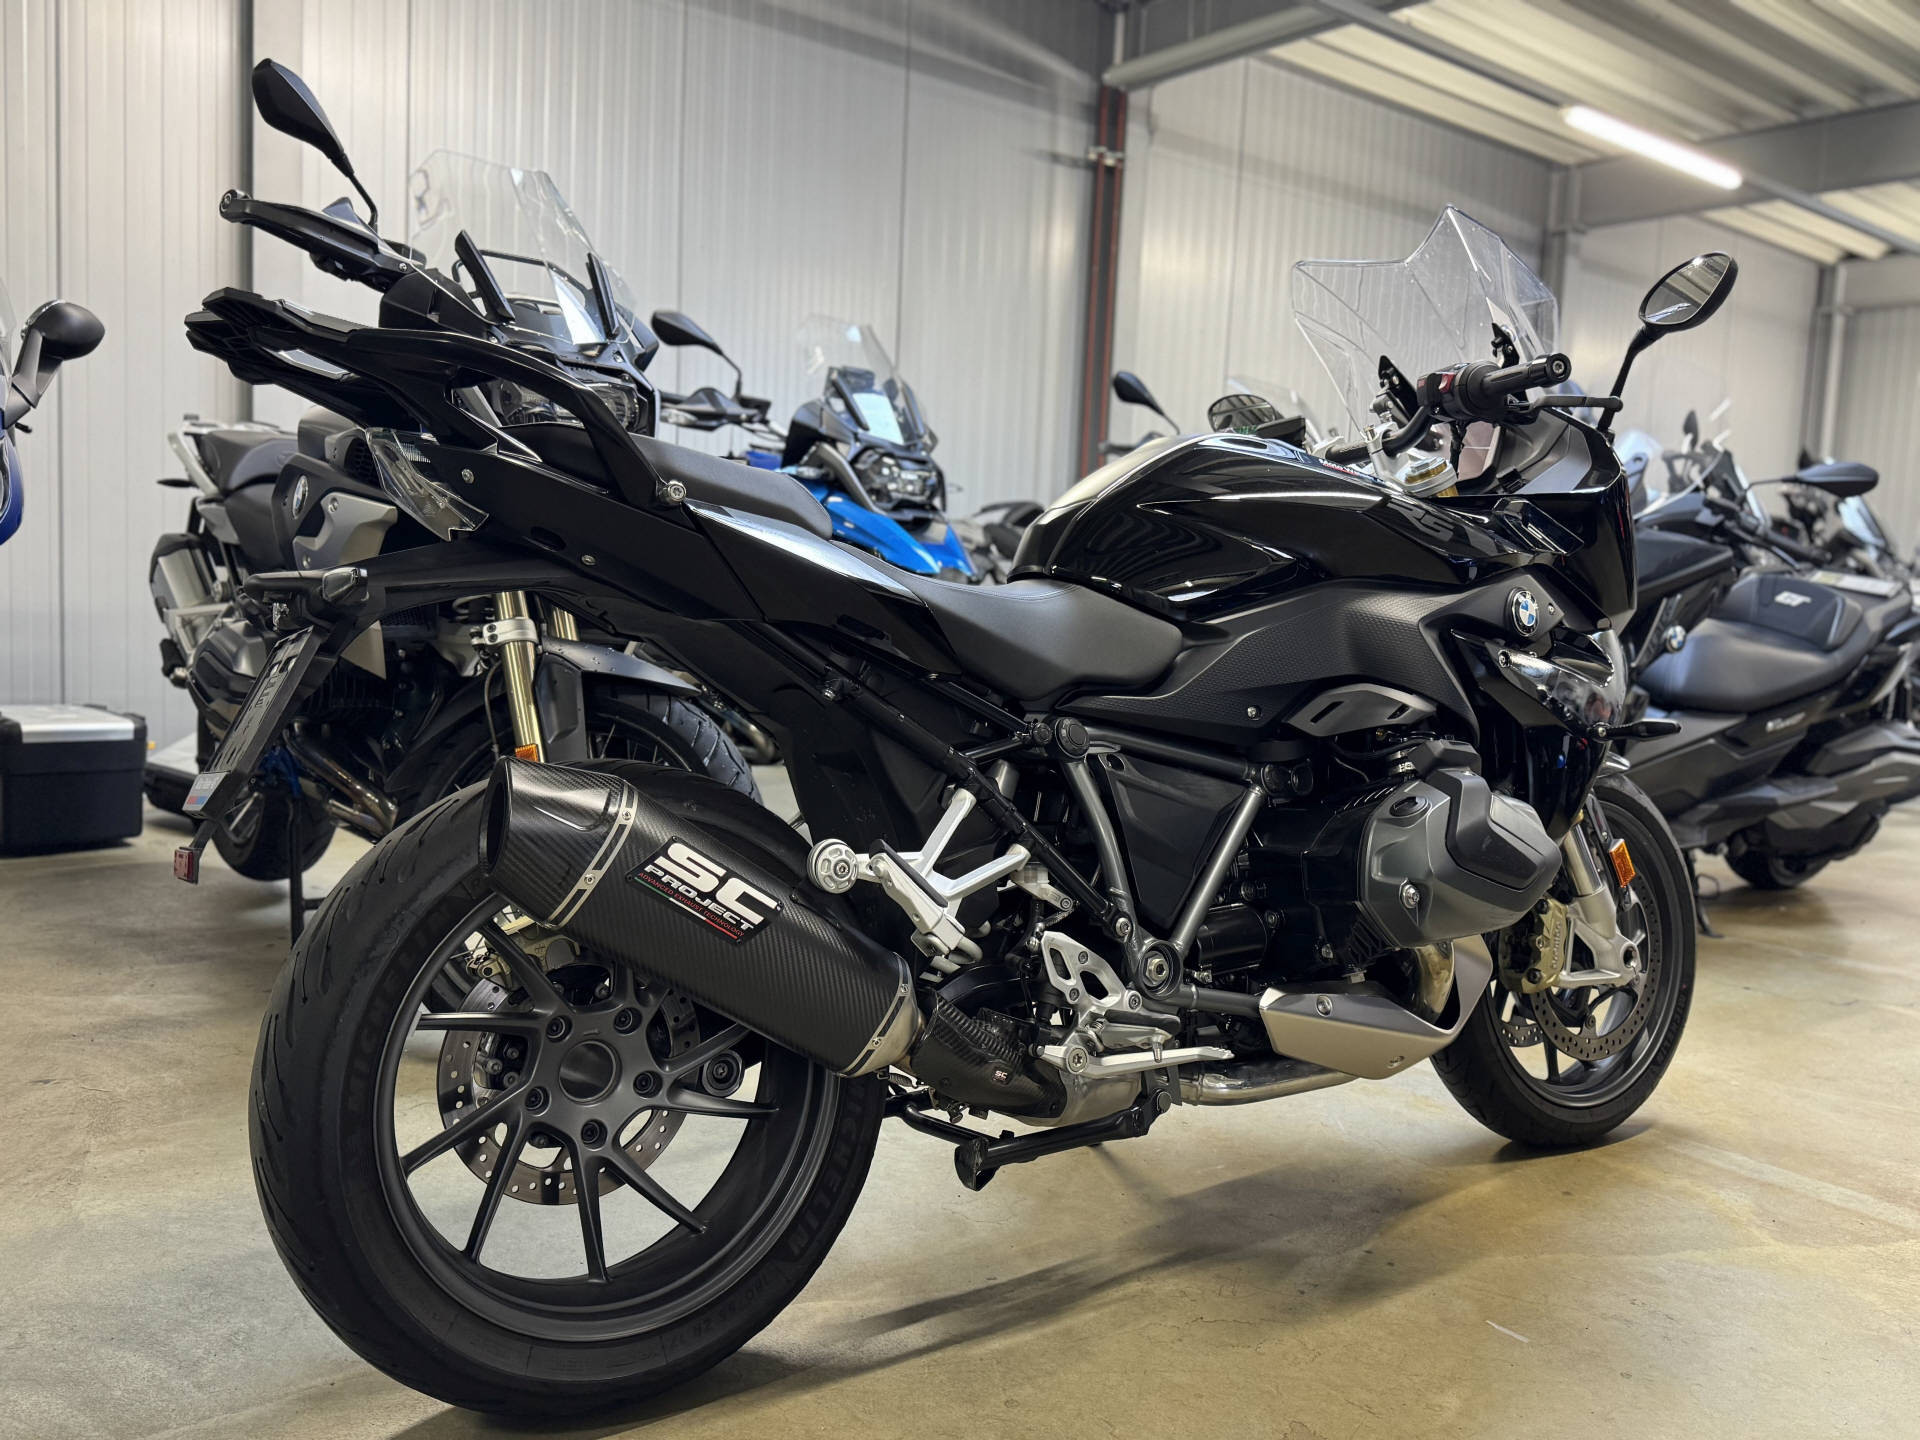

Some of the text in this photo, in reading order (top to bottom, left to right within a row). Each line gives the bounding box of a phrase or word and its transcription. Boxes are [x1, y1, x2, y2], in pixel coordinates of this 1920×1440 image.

[1386, 497, 1455, 542] RS
[638, 871, 745, 937] ADVANCED EXHAUST TECHNOLOGY
[643, 864, 754, 931] PROJECT
[653, 842, 778, 925] SC
